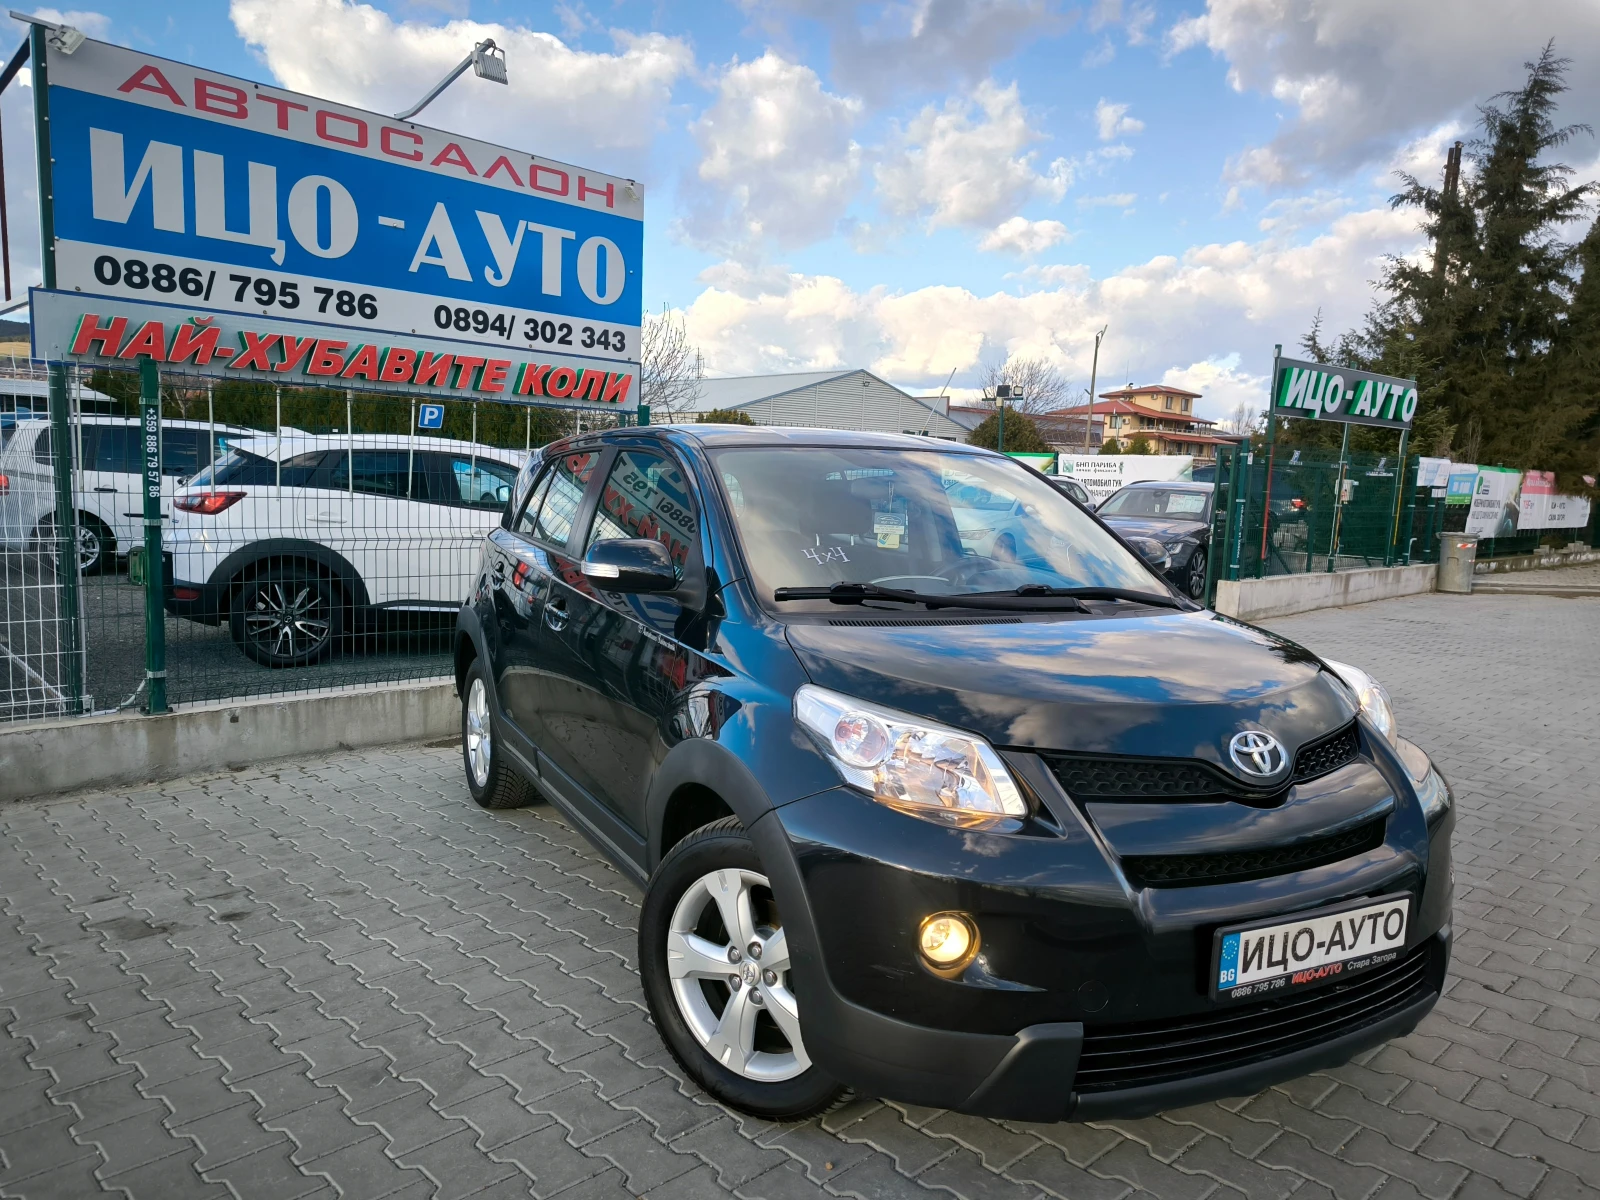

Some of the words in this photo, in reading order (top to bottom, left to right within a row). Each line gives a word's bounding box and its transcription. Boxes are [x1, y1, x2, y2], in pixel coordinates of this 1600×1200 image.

[117, 64, 616, 209] АВТОСАЛОН
[94, 255, 216, 301] 0886/
[229, 274, 300, 309] 795
[313, 286, 378, 319] 786
[434, 304, 515, 340] 0894/
[523, 317, 573, 346] 302
[581, 328, 626, 353] 343
[69, 313, 511, 392] НАЙ-ХУБАВИТЕ
[514, 362, 633, 403] КОЛИ
[146, 408, 157, 432] +359
[146, 435, 158, 453] 886
[147, 456, 159, 468] 79
[148, 471, 159, 483] 57
[149, 485, 160, 498] 86
[1241, 907, 1404, 974] ИЦО-АУТО
[1347, 957, 1370, 971] Стара
[1371, 951, 1397, 967] Загора
[1220, 968, 1235, 984] BG
[1291, 962, 1343, 985] ИЦО-АУТО
[1231, 984, 1253, 999] 0886
[1253, 981, 1269, 994] 795
[1270, 977, 1286, 991] 786
